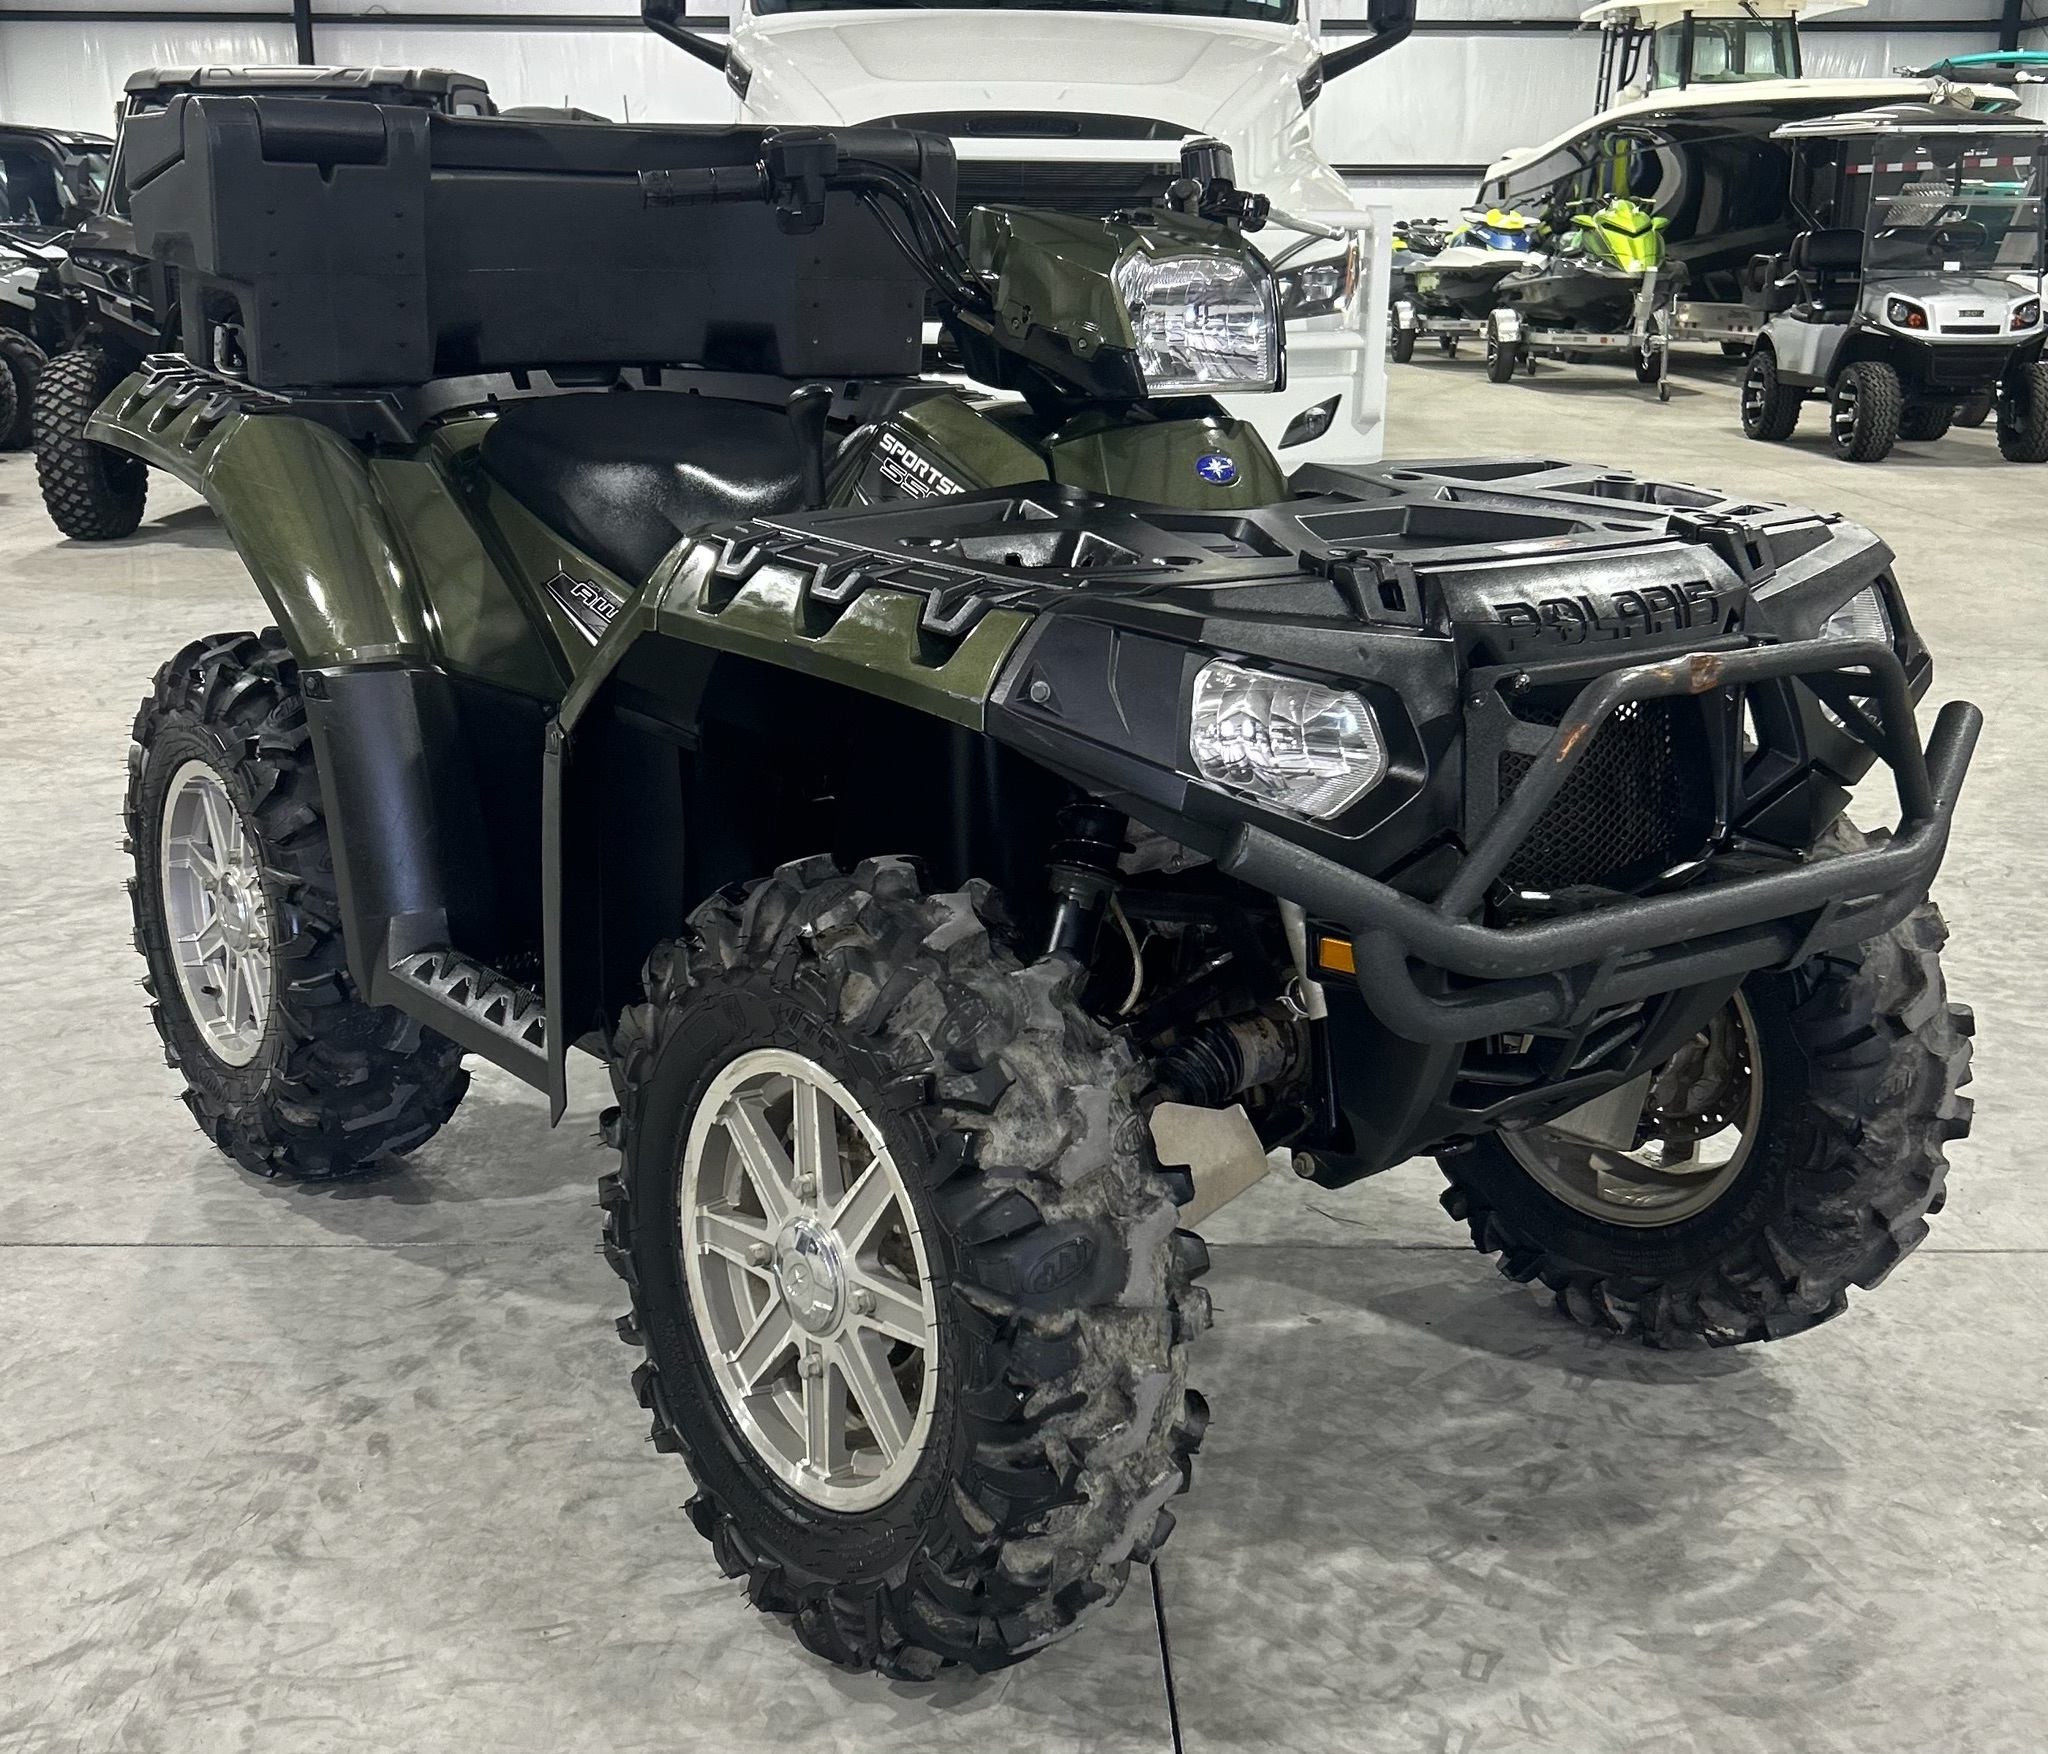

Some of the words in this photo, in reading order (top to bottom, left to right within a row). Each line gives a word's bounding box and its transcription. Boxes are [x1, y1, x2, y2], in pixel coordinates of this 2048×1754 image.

[879, 456, 939, 500] 55
[880, 432, 966, 496] SPORTS
[570, 582, 620, 624] AW
[1493, 579, 1719, 650] POLARIS
